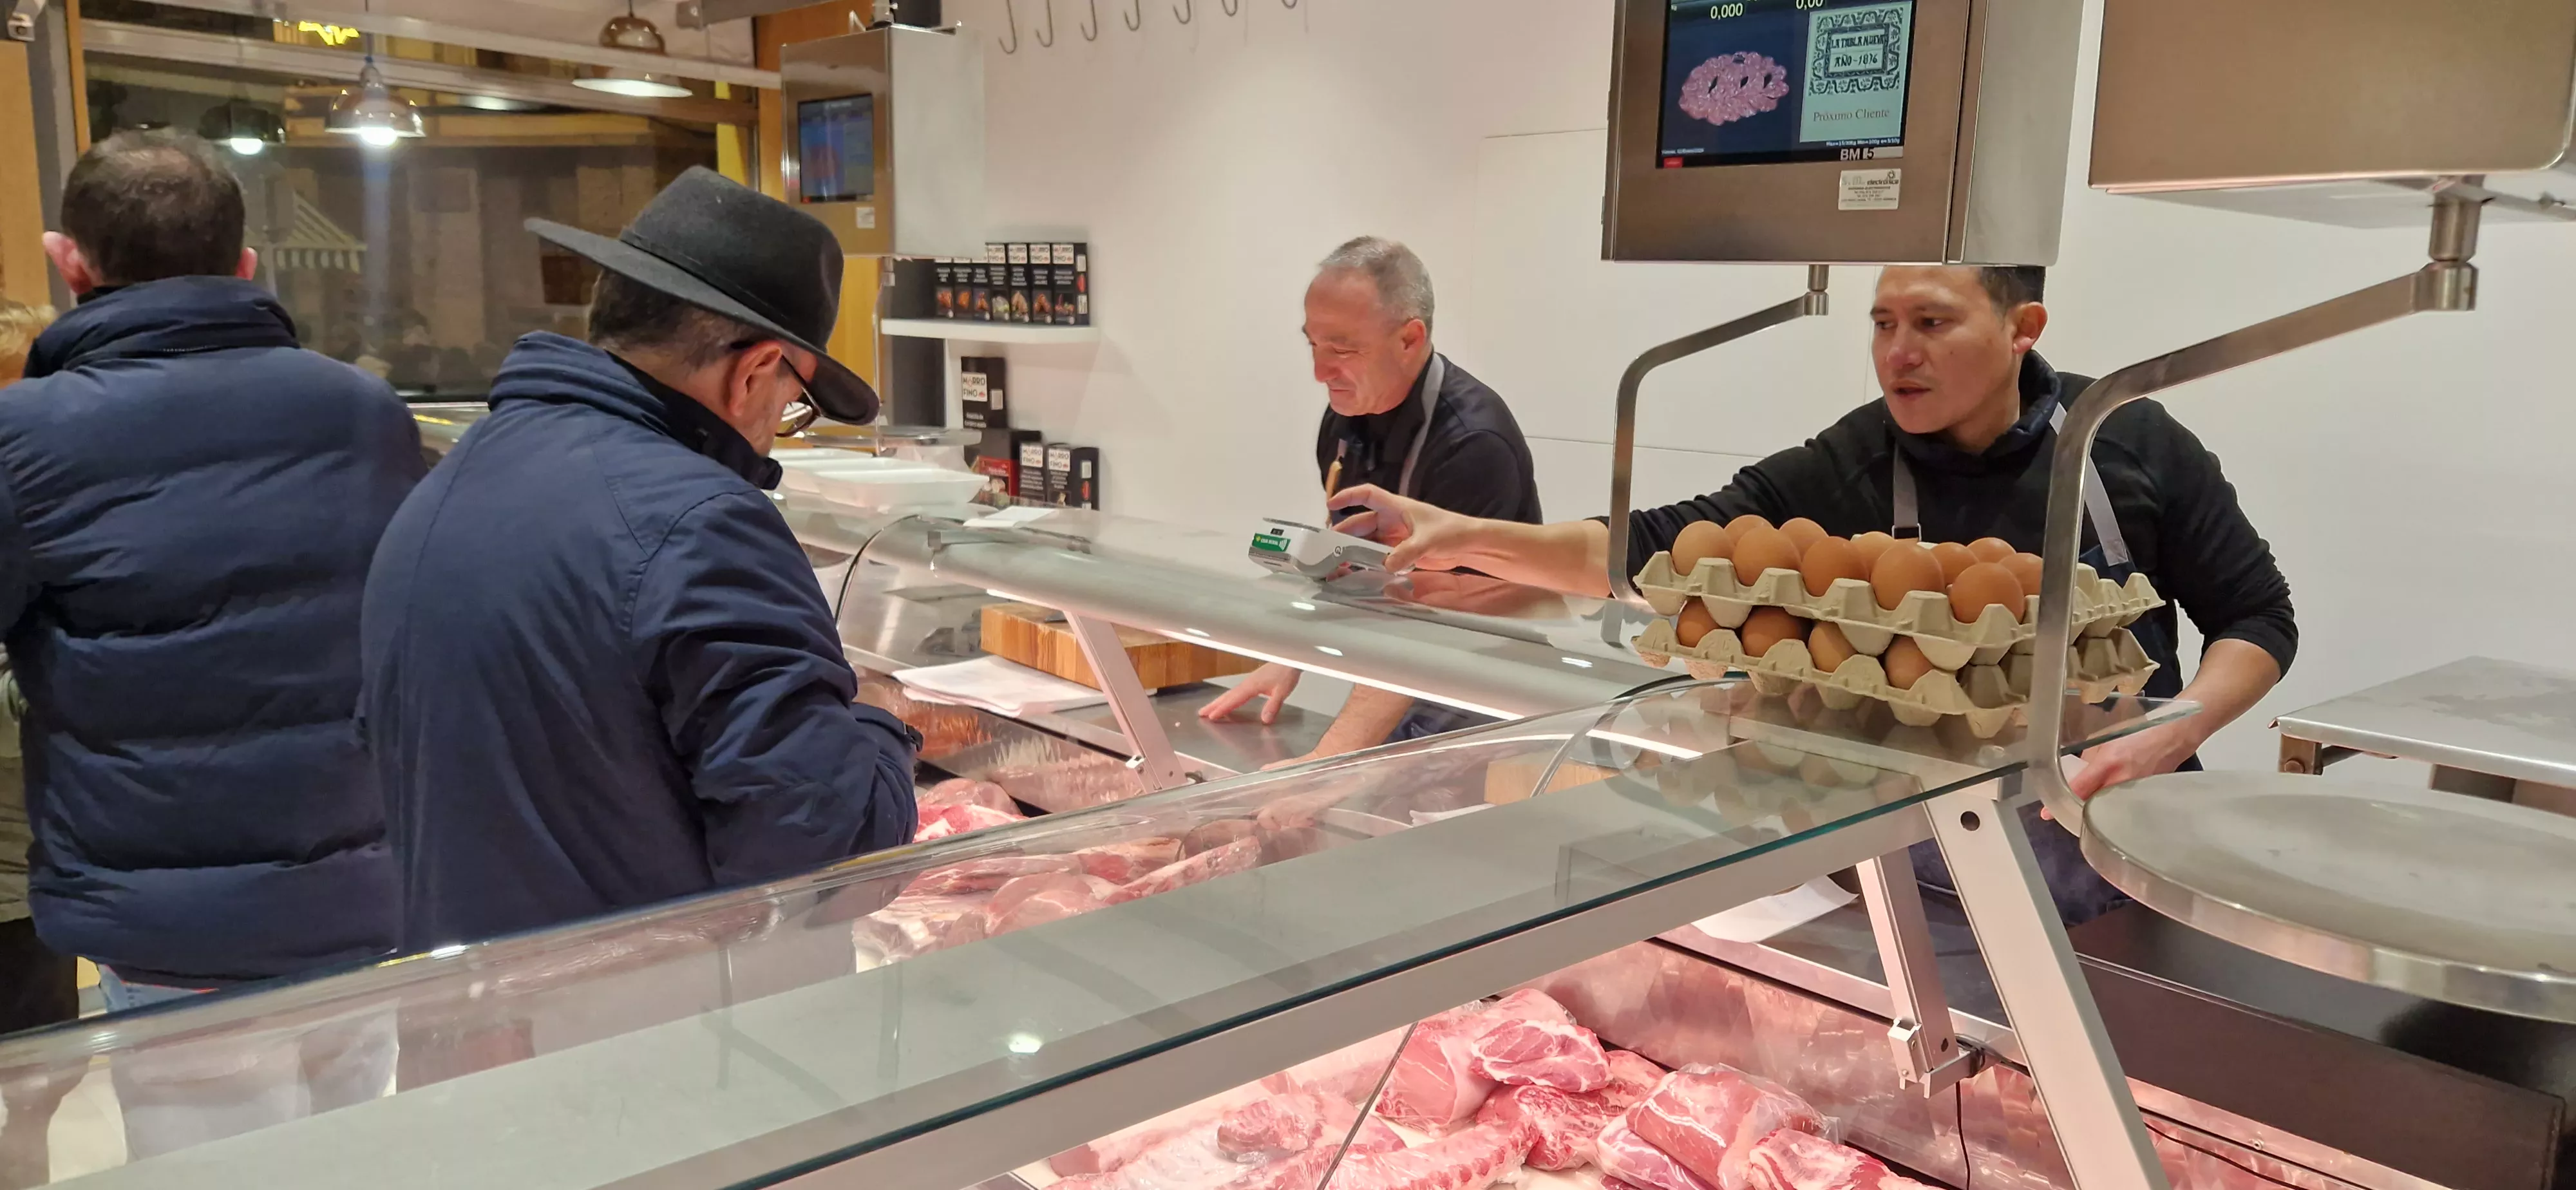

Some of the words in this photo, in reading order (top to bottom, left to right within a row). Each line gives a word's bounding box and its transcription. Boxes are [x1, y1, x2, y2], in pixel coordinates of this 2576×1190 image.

[1710, 3, 1744, 20] 0,000
[1813, 111, 1853, 122] Próximo
[1855, 108, 1889, 119] Cliente
[1840, 147, 1861, 160] BM
